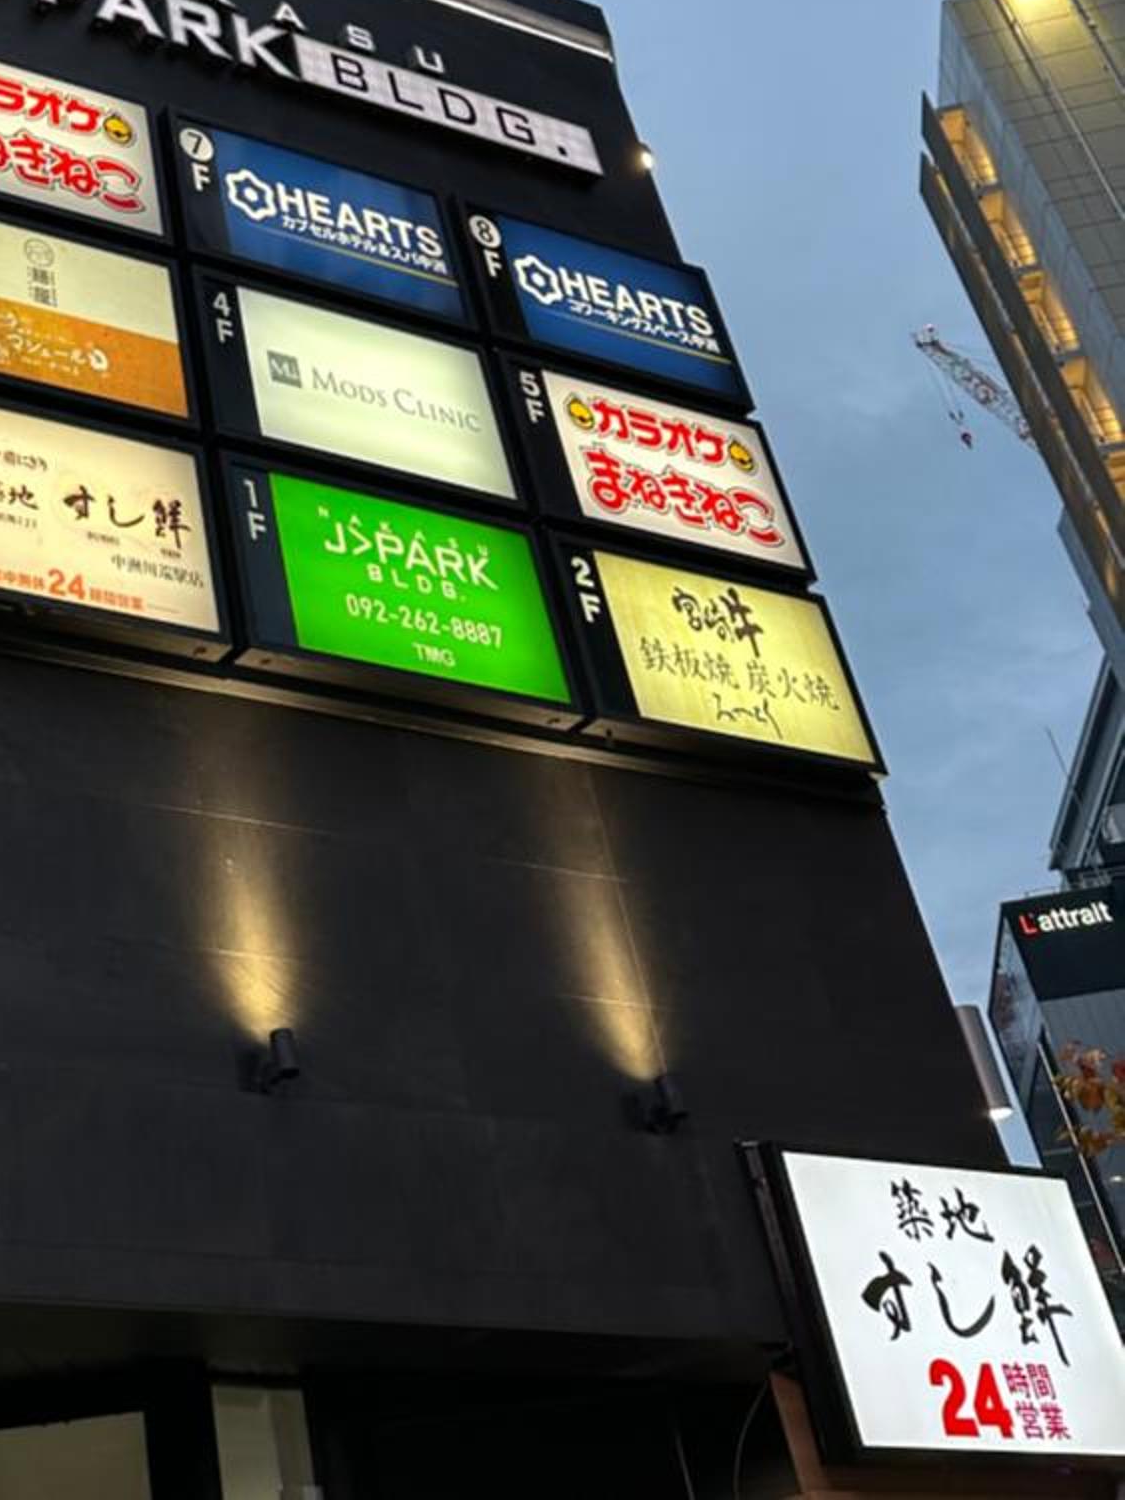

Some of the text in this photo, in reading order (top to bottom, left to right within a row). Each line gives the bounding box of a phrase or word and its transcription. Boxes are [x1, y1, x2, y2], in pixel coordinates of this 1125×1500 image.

[332, 53, 569, 157] BLDG.
[184, 131, 211, 191] 7F
[275, 181, 443, 257] HEARTS
[474, 218, 503, 277] 8F
[213, 291, 234, 343] 4F
[558, 266, 714, 336] HEARTS
[519, 371, 545, 423] 5F
[591, 399, 726, 464] カラオケ
[244, 479, 267, 541] 1F
[586, 448, 779, 543] まねきねこ
[345, 593, 503, 649] 092-262-8887
[570, 556, 602, 623] 2F
[671, 586, 764, 659] 宮崎牛
[639, 635, 841, 712] 鉄板焼 炭火焼
[889, 1177, 996, 1243] 築地
[860, 1244, 1075, 1367] すし鮮
[927, 1357, 1057, 1439] 24 時間
[1015, 1401, 1072, 1440] 営業
